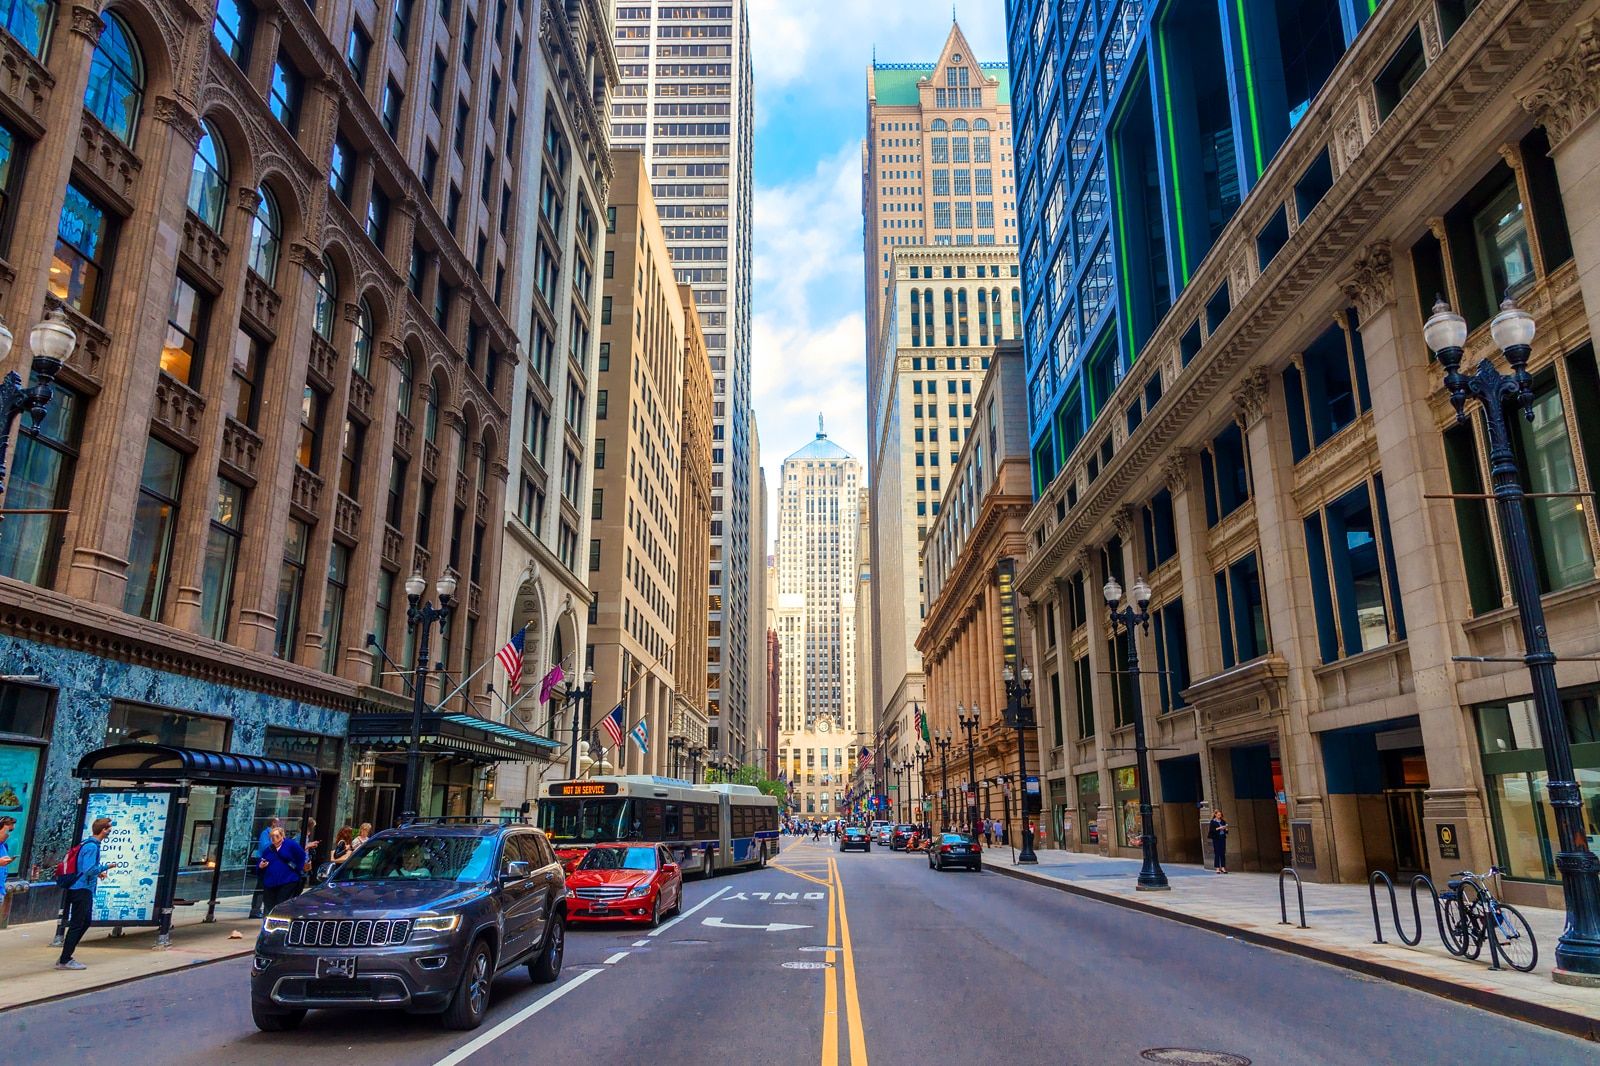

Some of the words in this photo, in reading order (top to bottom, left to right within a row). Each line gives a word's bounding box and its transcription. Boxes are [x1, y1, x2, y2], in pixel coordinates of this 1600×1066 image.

[563, 785, 574, 795] NOT
[575, 785, 581, 795] IN
[582, 785, 605, 795] SERVICE
[721, 892, 824, 900] ONLY
